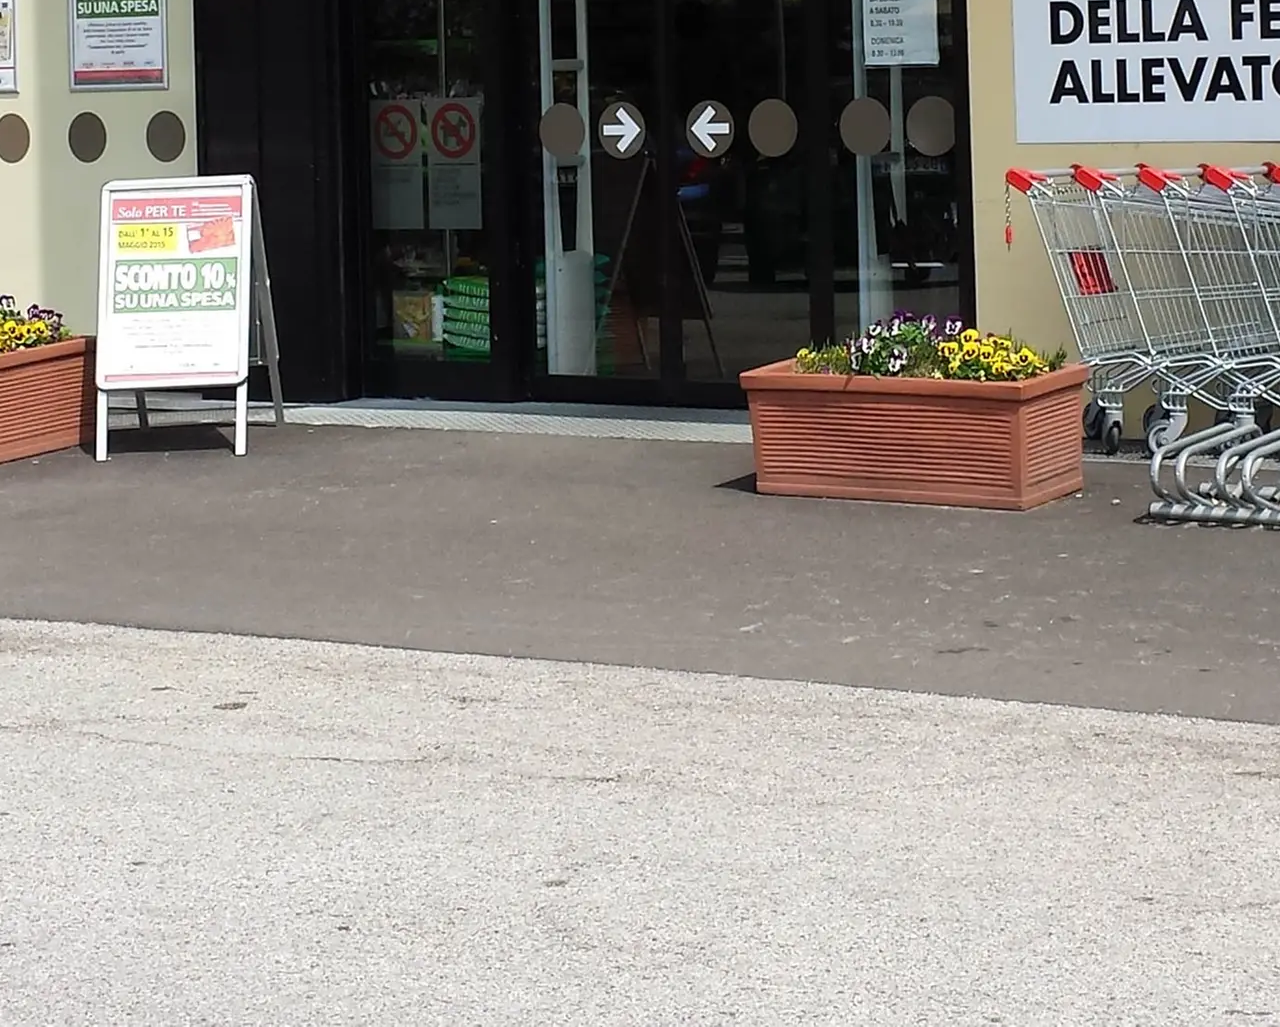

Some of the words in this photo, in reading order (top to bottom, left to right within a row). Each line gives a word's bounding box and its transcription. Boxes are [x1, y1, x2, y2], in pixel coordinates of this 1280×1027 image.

[78, 1, 92, 15] SU
[93, 0, 119, 14] UNA
[120, 0, 158, 13] SPESA
[117, 206, 142, 218] Solo
[145, 205, 168, 217] PER
[171, 205, 186, 217] TE
[151, 229, 161, 237] AL
[163, 226, 174, 237] 15
[118, 241, 149, 249] MAGGIO
[115, 262, 198, 292] SCONTO
[114, 293, 139, 310] SU
[140, 292, 180, 309] UNA
[180, 290, 236, 307] SPESA
